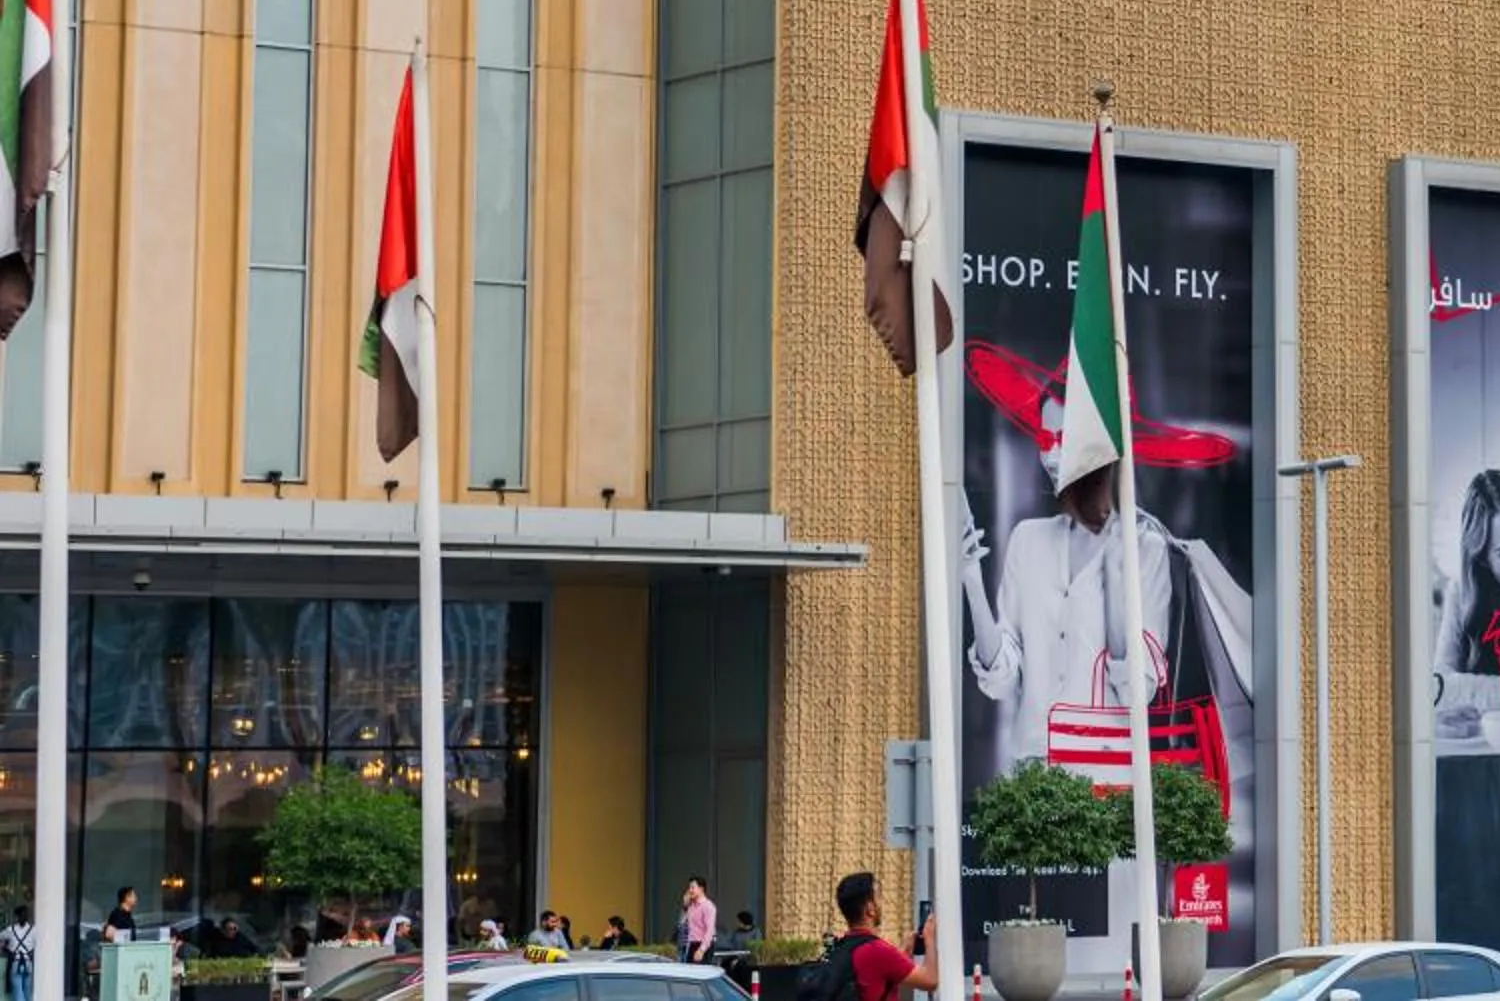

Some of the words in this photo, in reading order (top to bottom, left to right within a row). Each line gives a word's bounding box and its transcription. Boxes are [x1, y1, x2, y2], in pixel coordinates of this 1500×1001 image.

[962, 253, 1051, 289] SHOP.
[1067, 260, 1161, 296] EN.
[1175, 267, 1227, 301] FLY.
